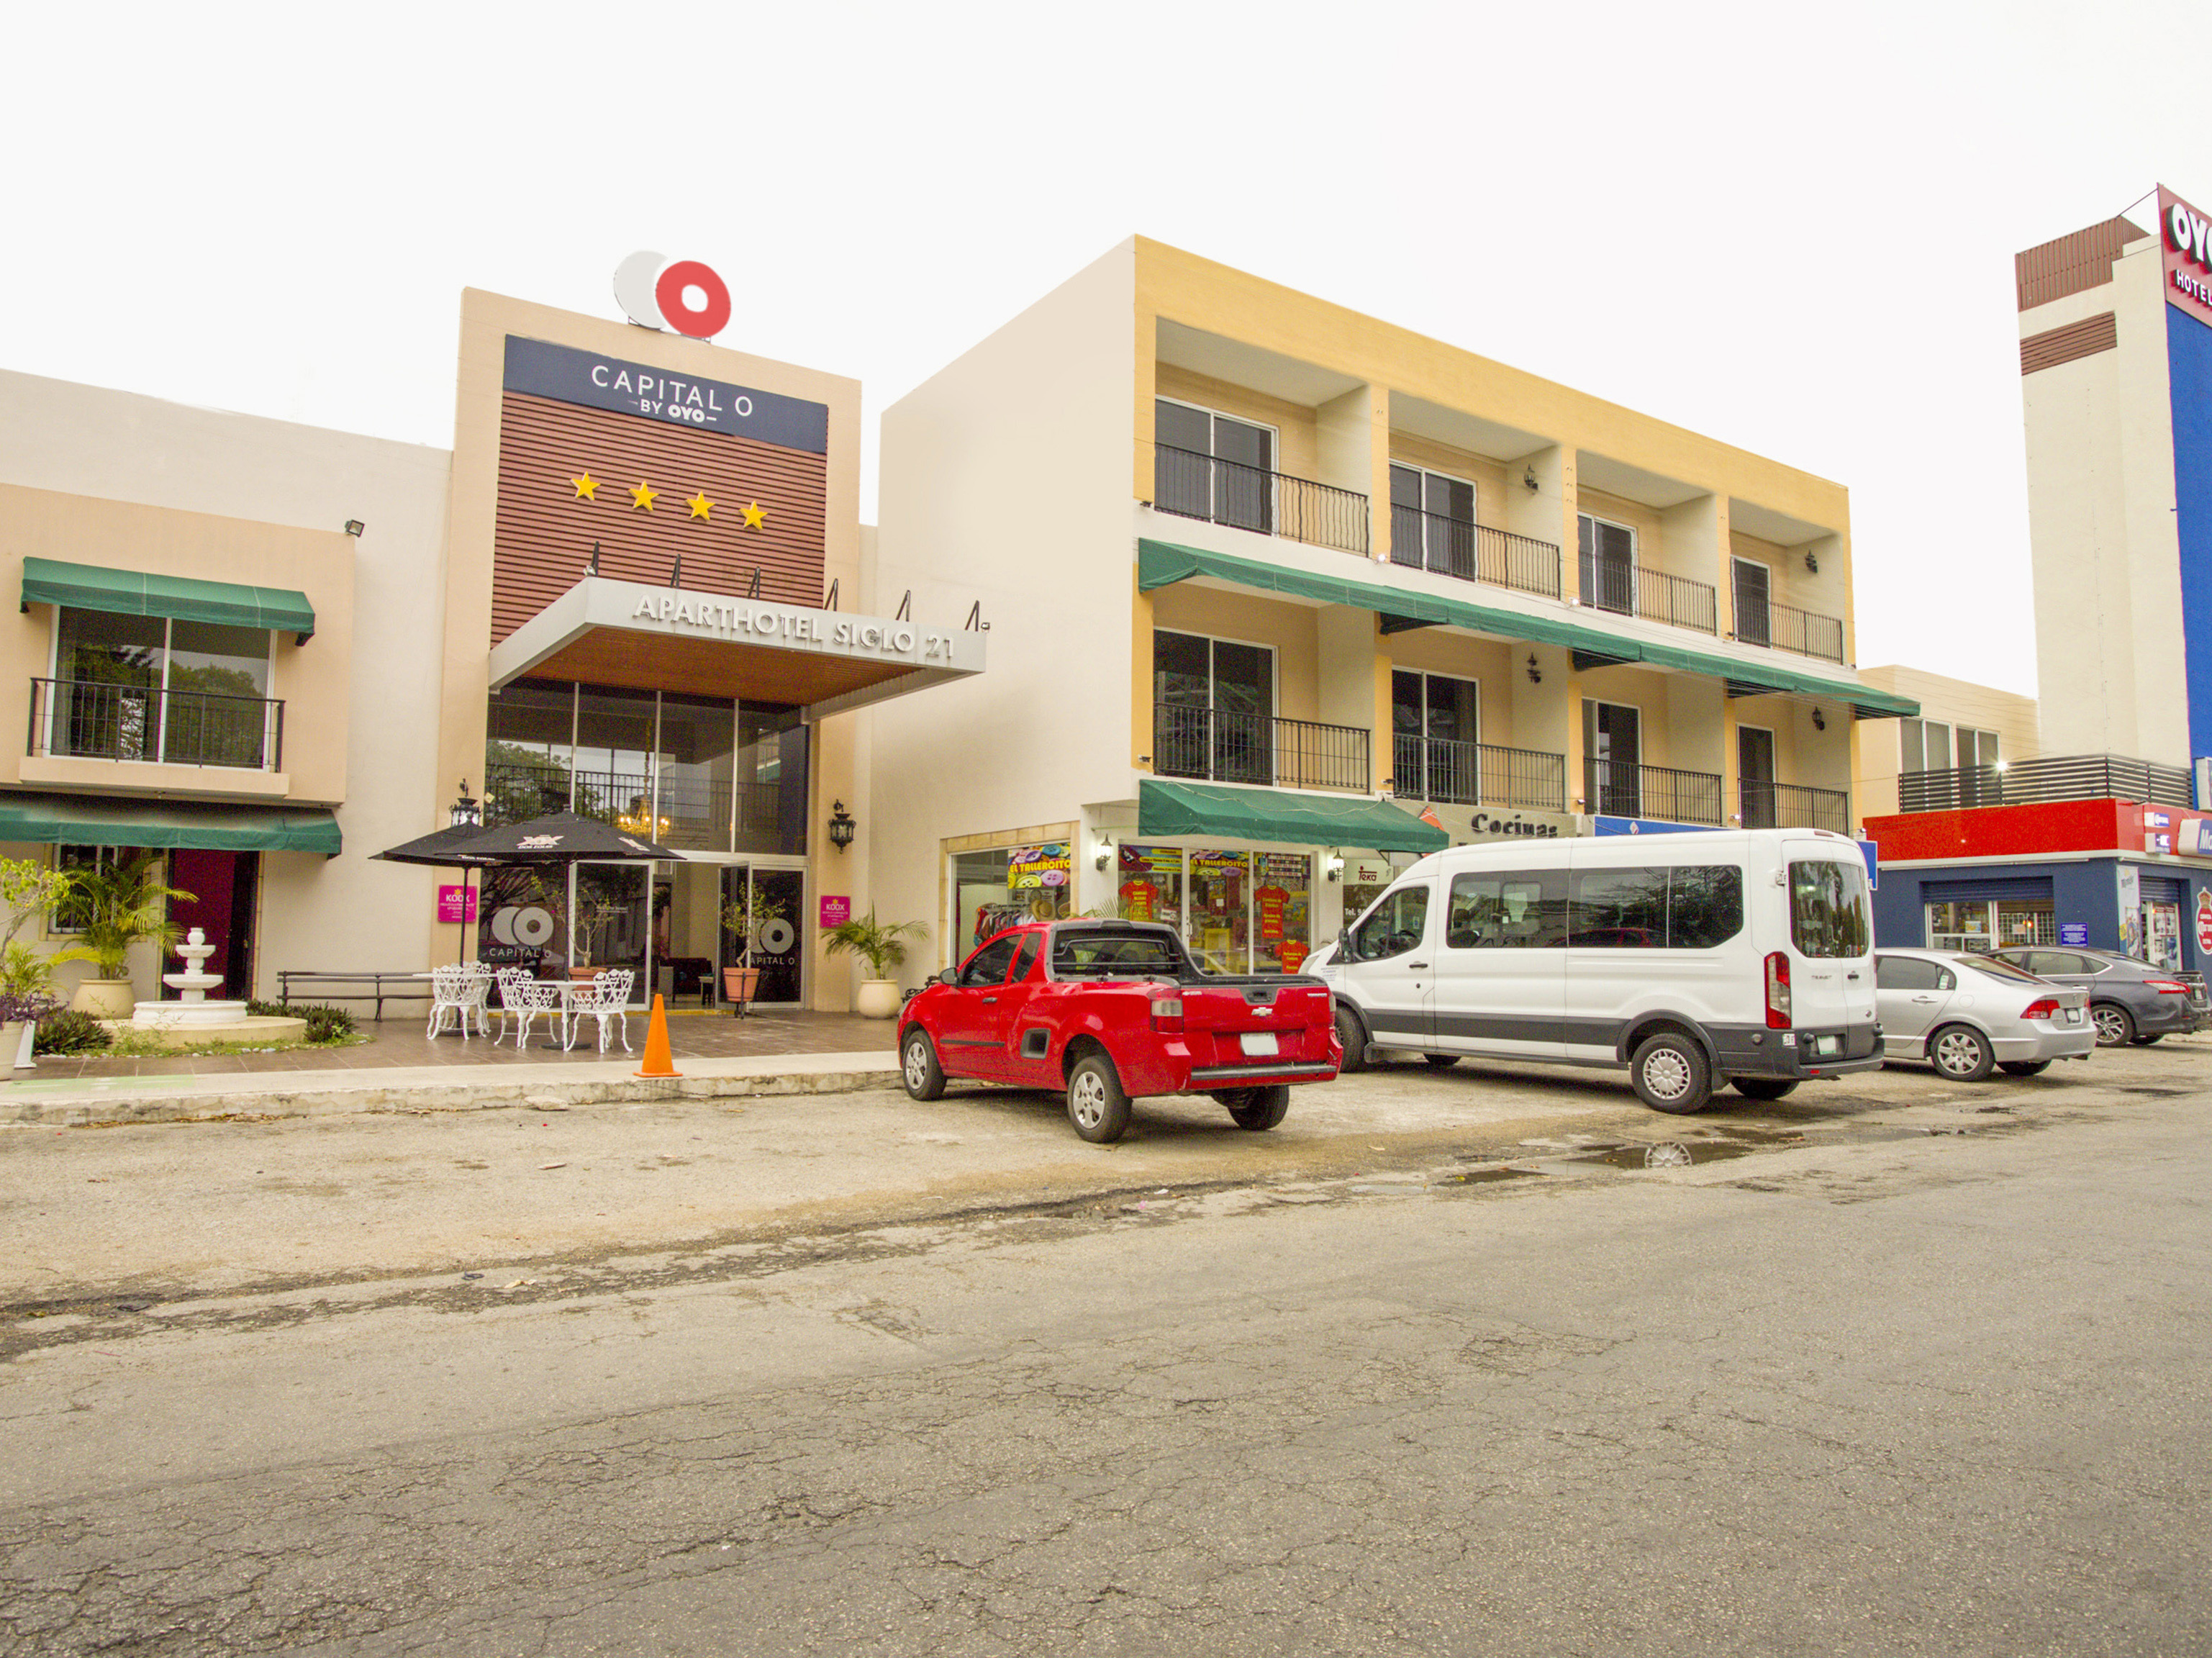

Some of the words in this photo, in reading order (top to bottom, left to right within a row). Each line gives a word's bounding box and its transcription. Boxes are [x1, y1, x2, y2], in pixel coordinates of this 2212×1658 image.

[591, 365, 722, 412] CAPITAL
[735, 396, 753, 417] O
[640, 399, 663, 414] BY
[668, 404, 705, 423] OYO
[633, 594, 824, 642] APARTHOTEL
[833, 621, 915, 652] SIGLO
[925, 634, 954, 658] 21
[1471, 813, 1558, 838] Cocinas
[1009, 864, 1018, 873] EL
[1020, 859, 1071, 872] TALLERCITO
[489, 948, 540, 958] CAPITAL
[544, 949, 552, 959] O
[750, 956, 784, 965] APITAL
